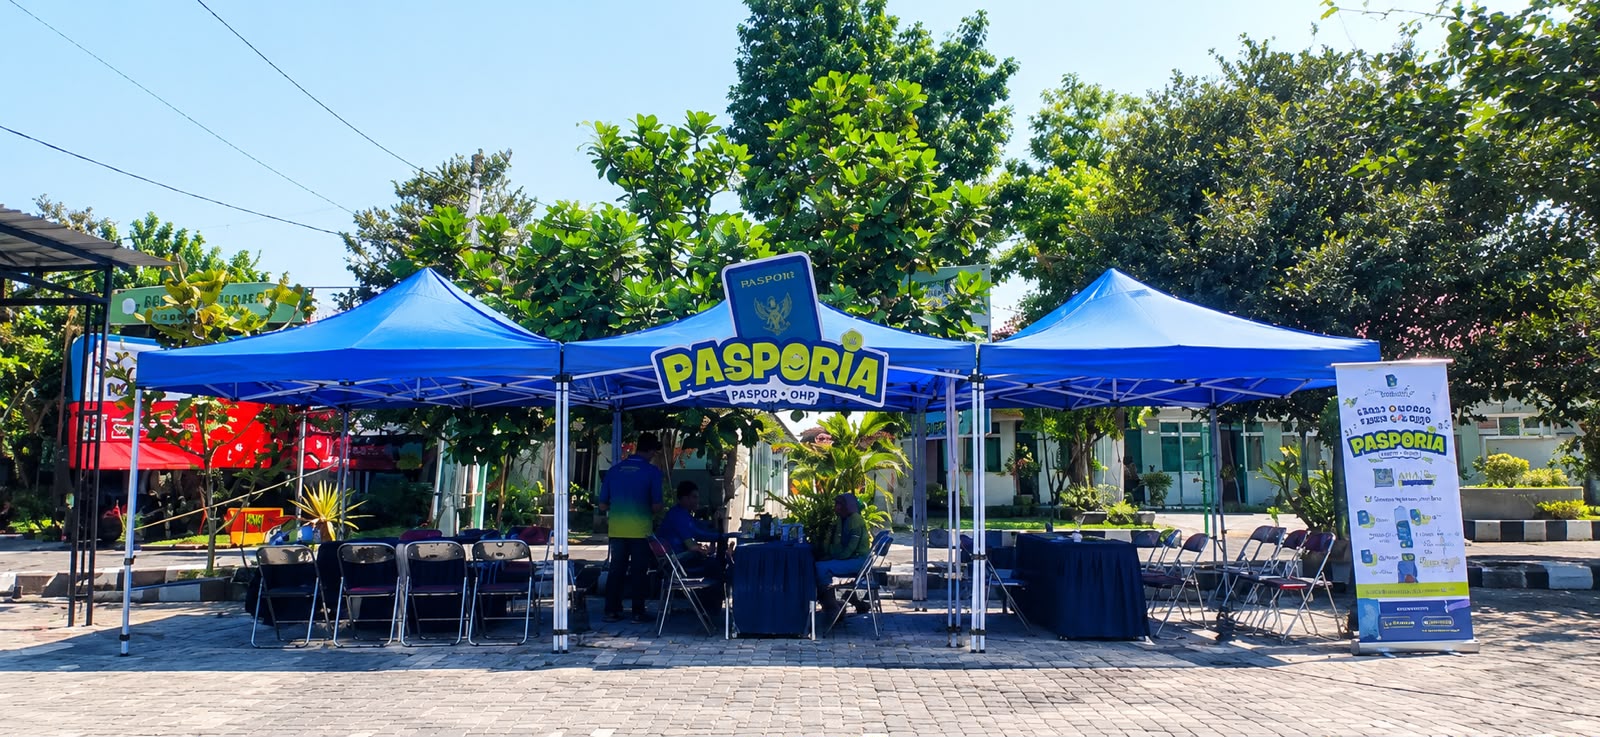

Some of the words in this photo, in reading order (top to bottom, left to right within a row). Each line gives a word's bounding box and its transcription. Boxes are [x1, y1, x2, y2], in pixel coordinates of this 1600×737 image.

[662, 337, 879, 396] PASPORIA
[732, 389, 777, 400] PASPOR
[1350, 431, 1445, 455] PASPORIA
